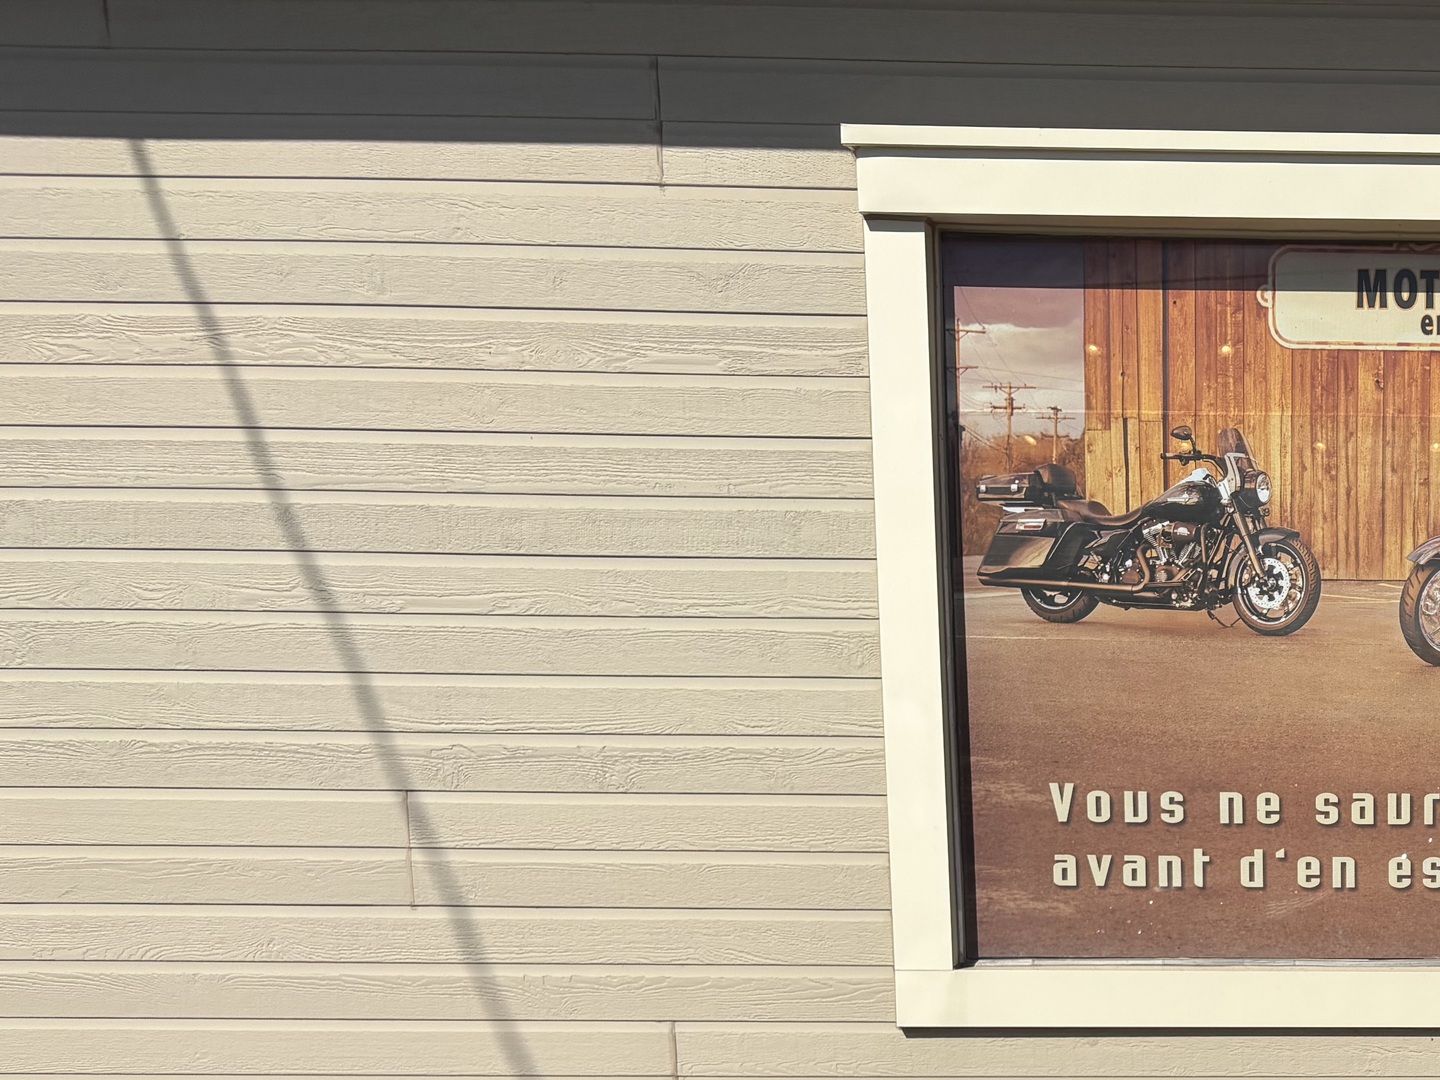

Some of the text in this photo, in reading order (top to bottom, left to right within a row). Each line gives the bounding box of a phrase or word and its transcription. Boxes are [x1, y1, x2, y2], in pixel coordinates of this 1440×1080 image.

[1049, 782, 1185, 824] Vous
[1219, 791, 1281, 825] ne
[1052, 848, 1211, 888] avant
